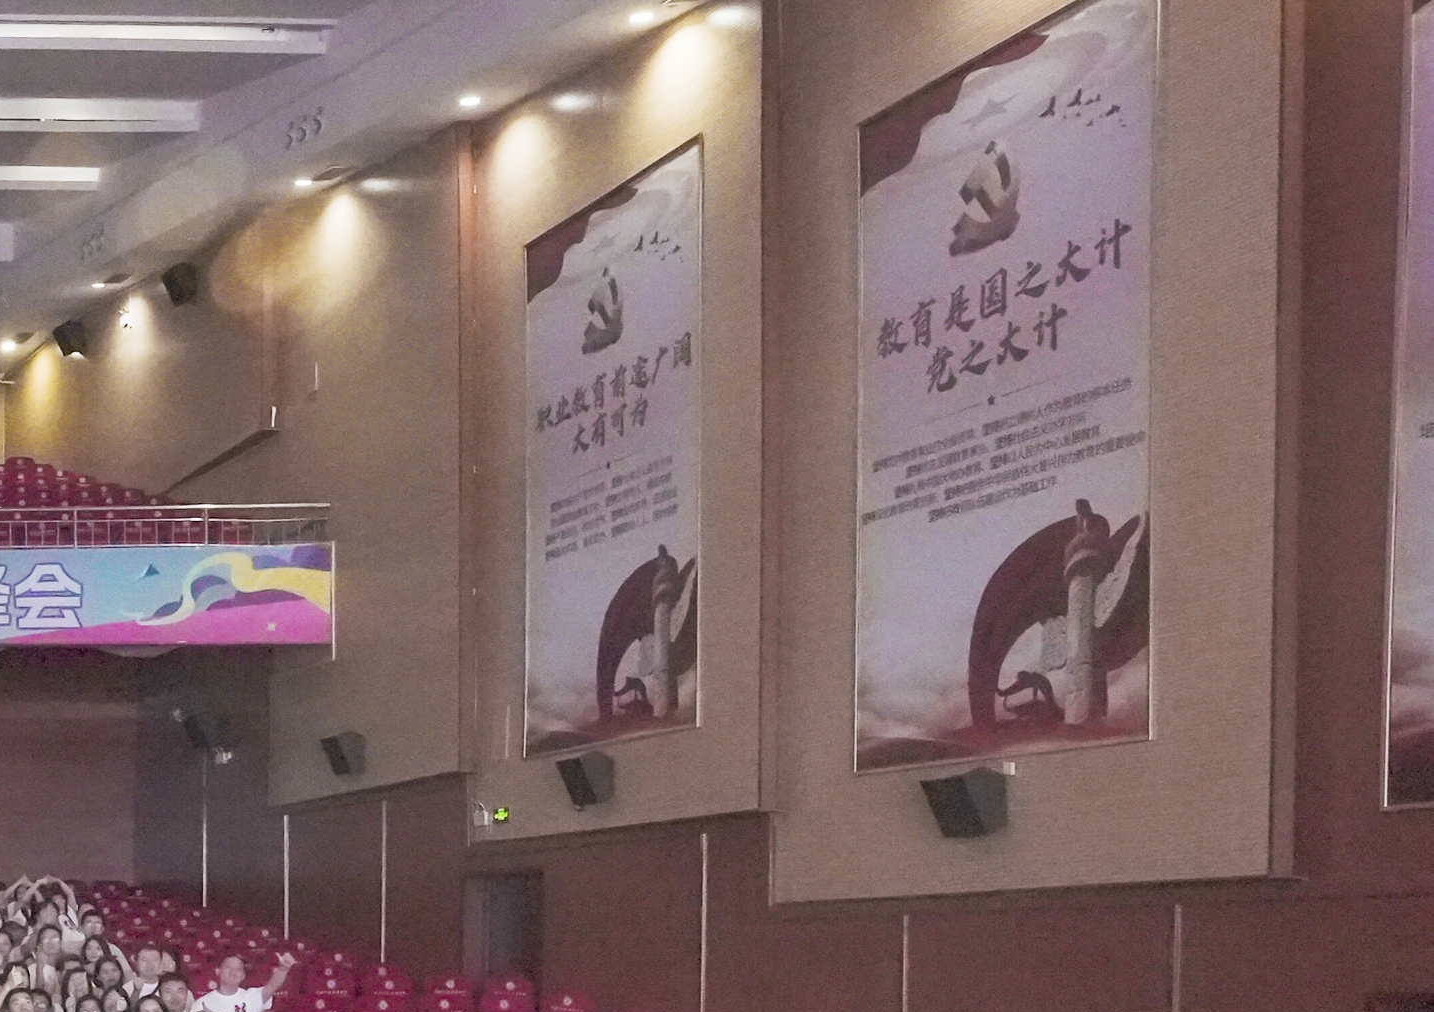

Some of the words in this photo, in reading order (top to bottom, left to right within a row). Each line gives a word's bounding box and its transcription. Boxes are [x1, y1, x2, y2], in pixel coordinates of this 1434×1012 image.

[877, 219, 1131, 358] 教育是国之大计
[927, 303, 1068, 394] 党之大计
[572, 393, 649, 455] 大有可为
